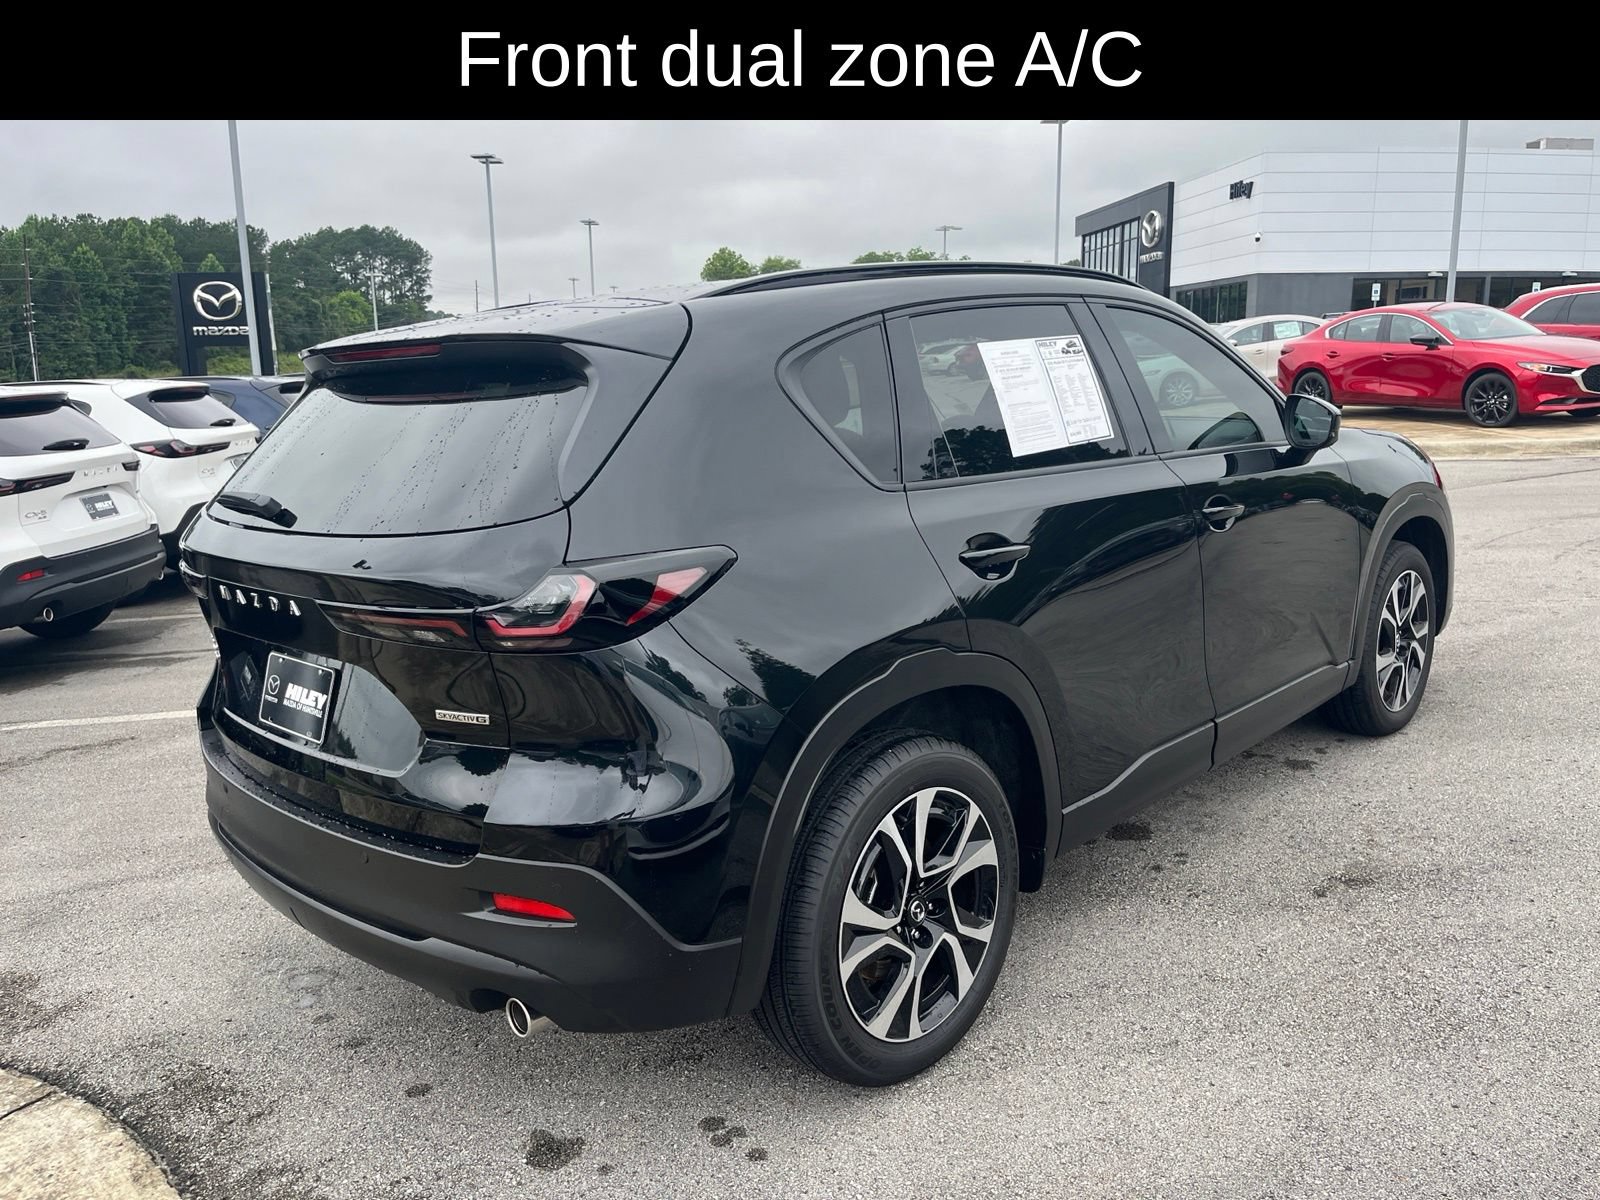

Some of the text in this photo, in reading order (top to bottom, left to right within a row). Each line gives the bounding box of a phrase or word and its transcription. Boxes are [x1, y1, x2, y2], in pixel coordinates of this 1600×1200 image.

[1229, 180, 1254, 200] Hiley
[219, 585, 301, 616] MAZDA
[285, 682, 328, 710] HILEY
